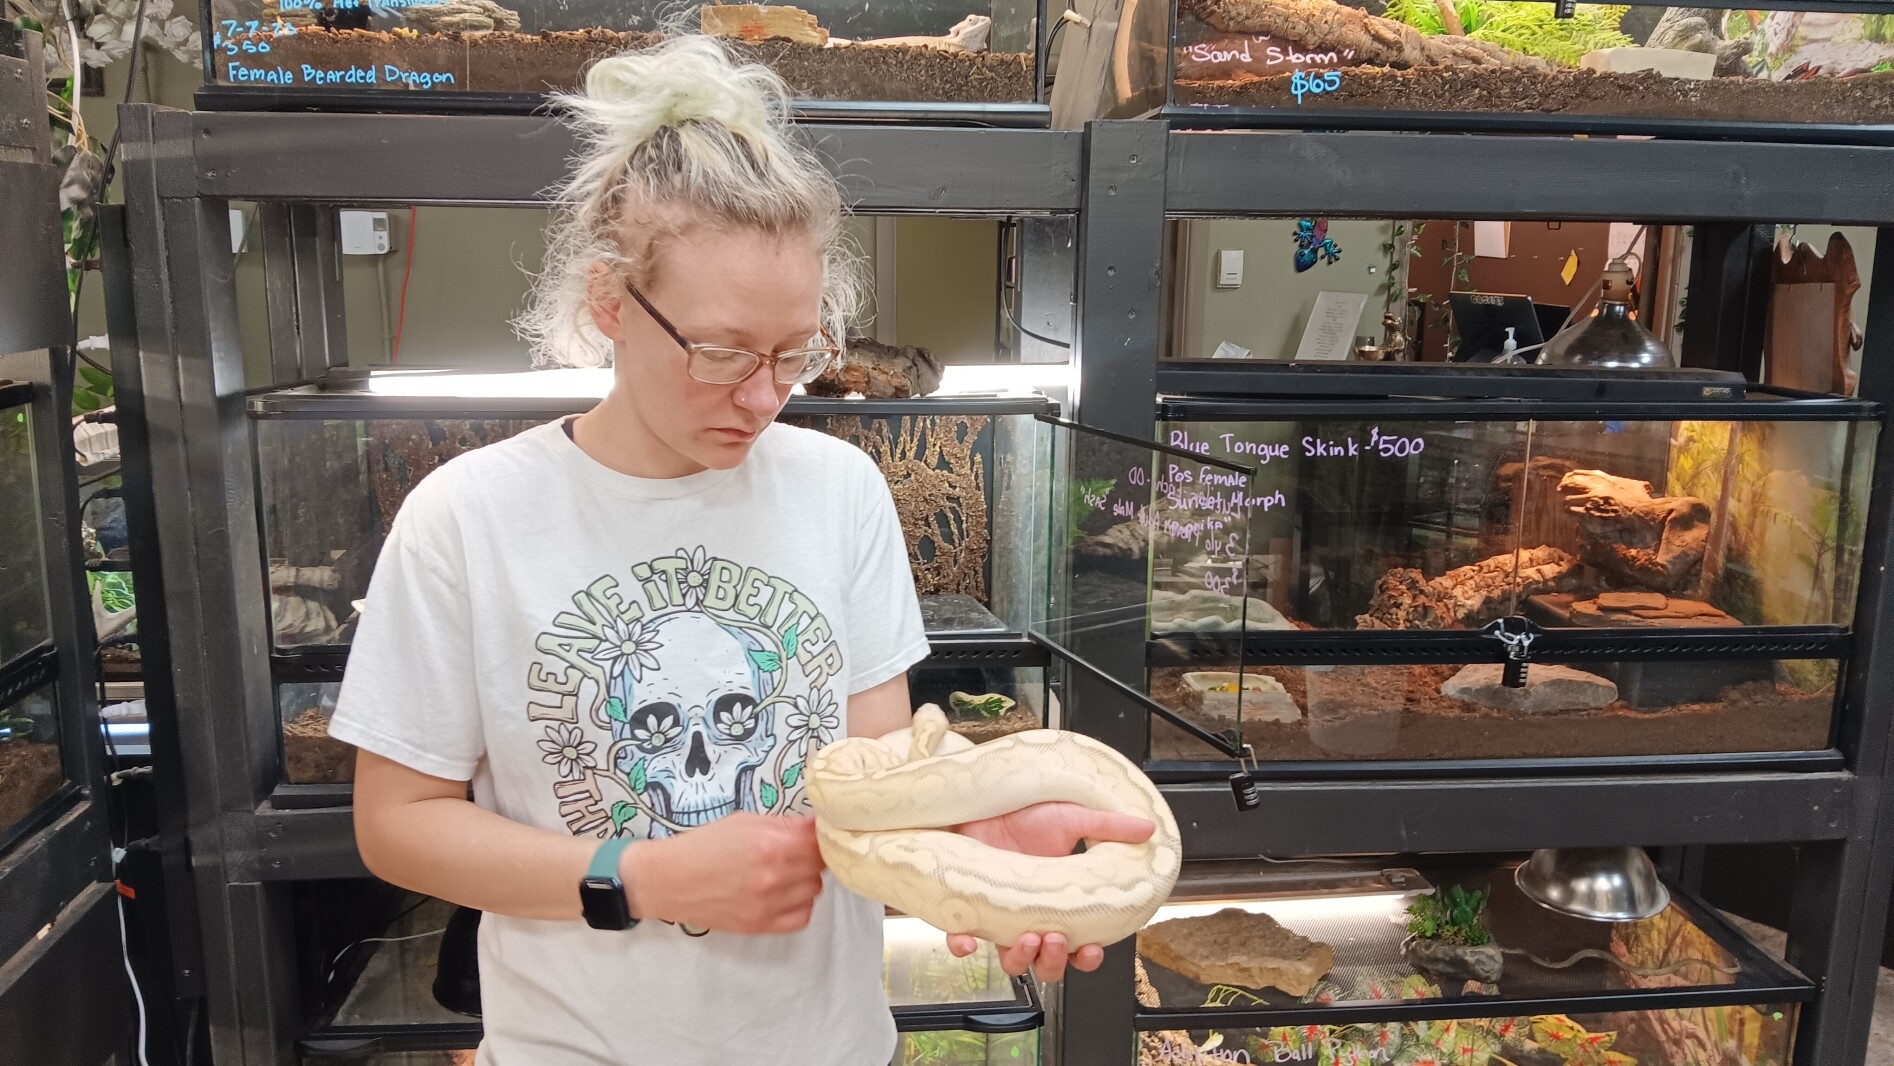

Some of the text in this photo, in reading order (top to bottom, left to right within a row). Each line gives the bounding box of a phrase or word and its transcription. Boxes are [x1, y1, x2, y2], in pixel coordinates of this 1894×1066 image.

[1290, 69, 1343, 104] $65
[1170, 430, 1210, 455] Blue
[1220, 433, 1290, 464] Tongue
[1301, 436, 1359, 457] Skink
[527, 574, 645, 724] LEAVE
[703, 557, 843, 689] BETTER
